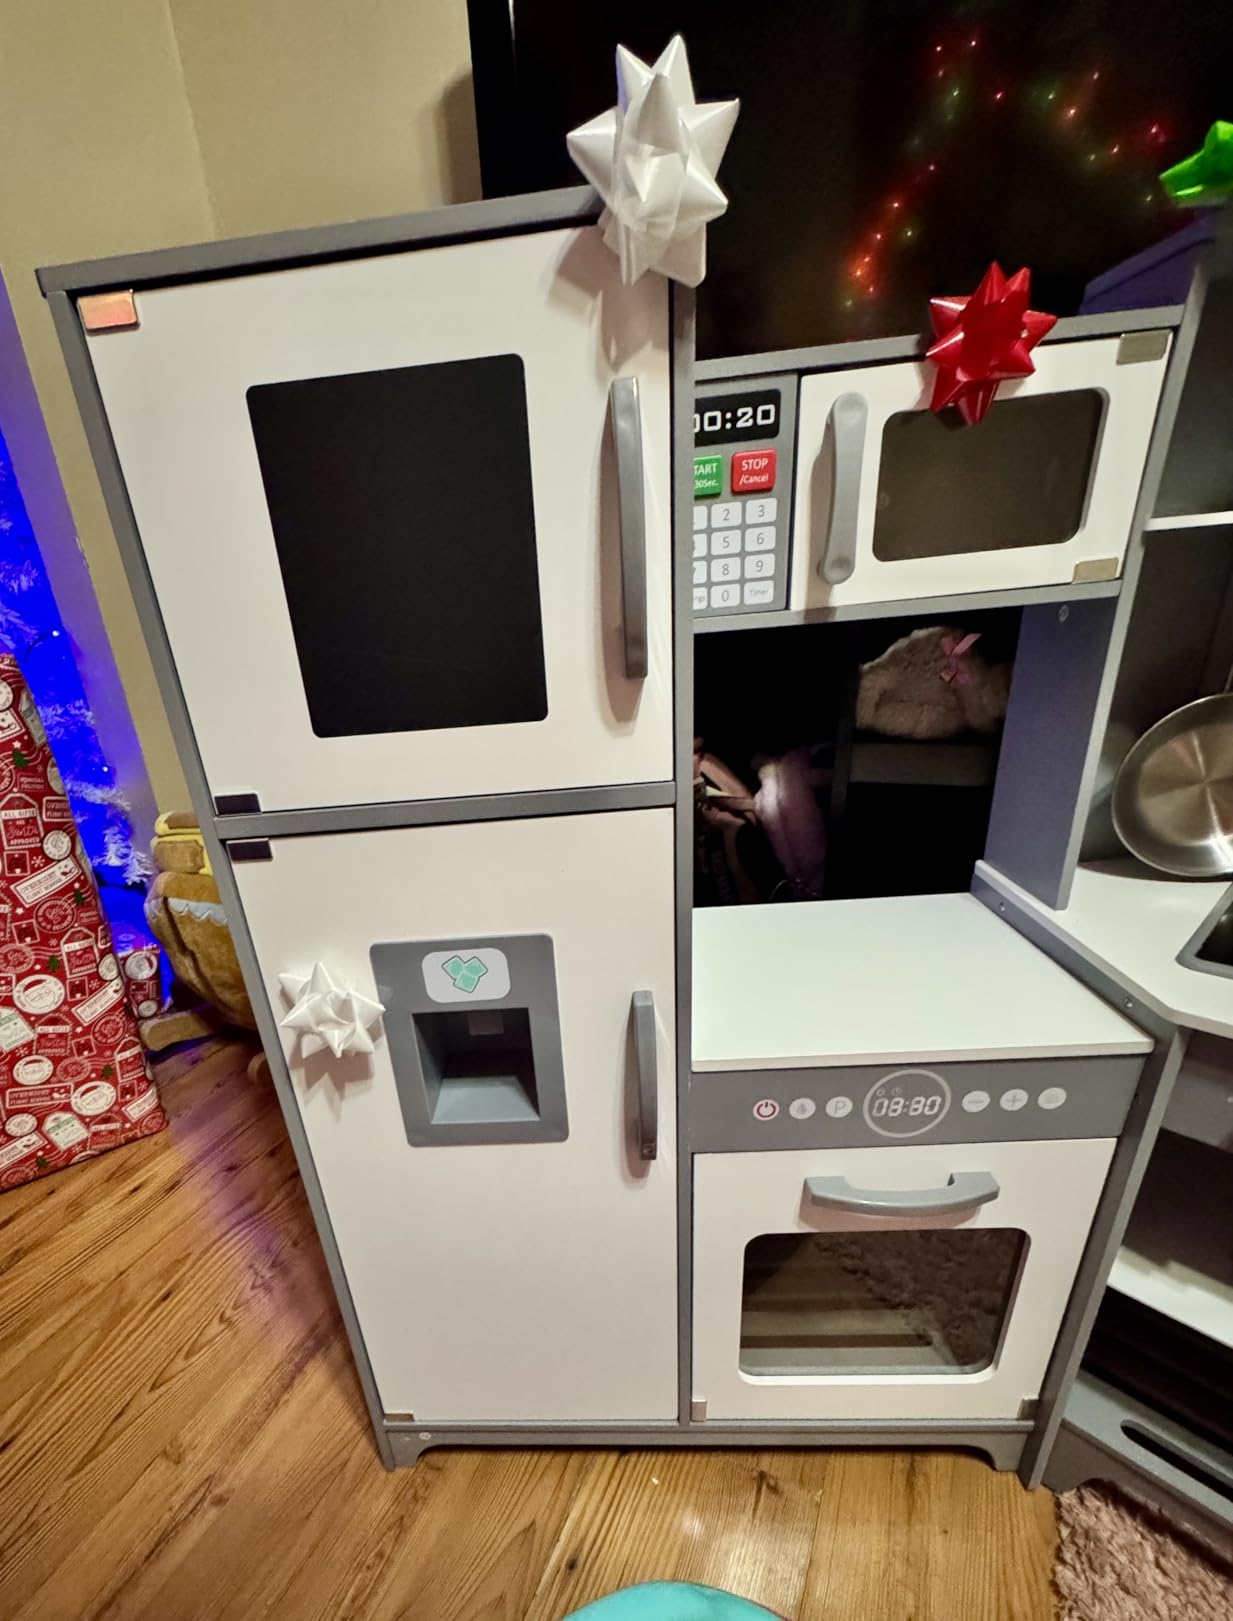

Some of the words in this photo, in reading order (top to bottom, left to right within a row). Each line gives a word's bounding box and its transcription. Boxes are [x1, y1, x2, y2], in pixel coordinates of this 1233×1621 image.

[694, 463, 718, 476] TART
[741, 458, 769, 471] STOP
[739, 473, 769, 486] /Cancel
[722, 508, 731, 521] 2
[757, 504, 766, 518] 3
[722, 536, 731, 549] 5
[756, 533, 765, 545] 6
[721, 563, 730, 576] 8
[755, 560, 764, 573] 9
[721, 589, 730, 602] 0
[871, 1095, 943, 1117] 08:80
